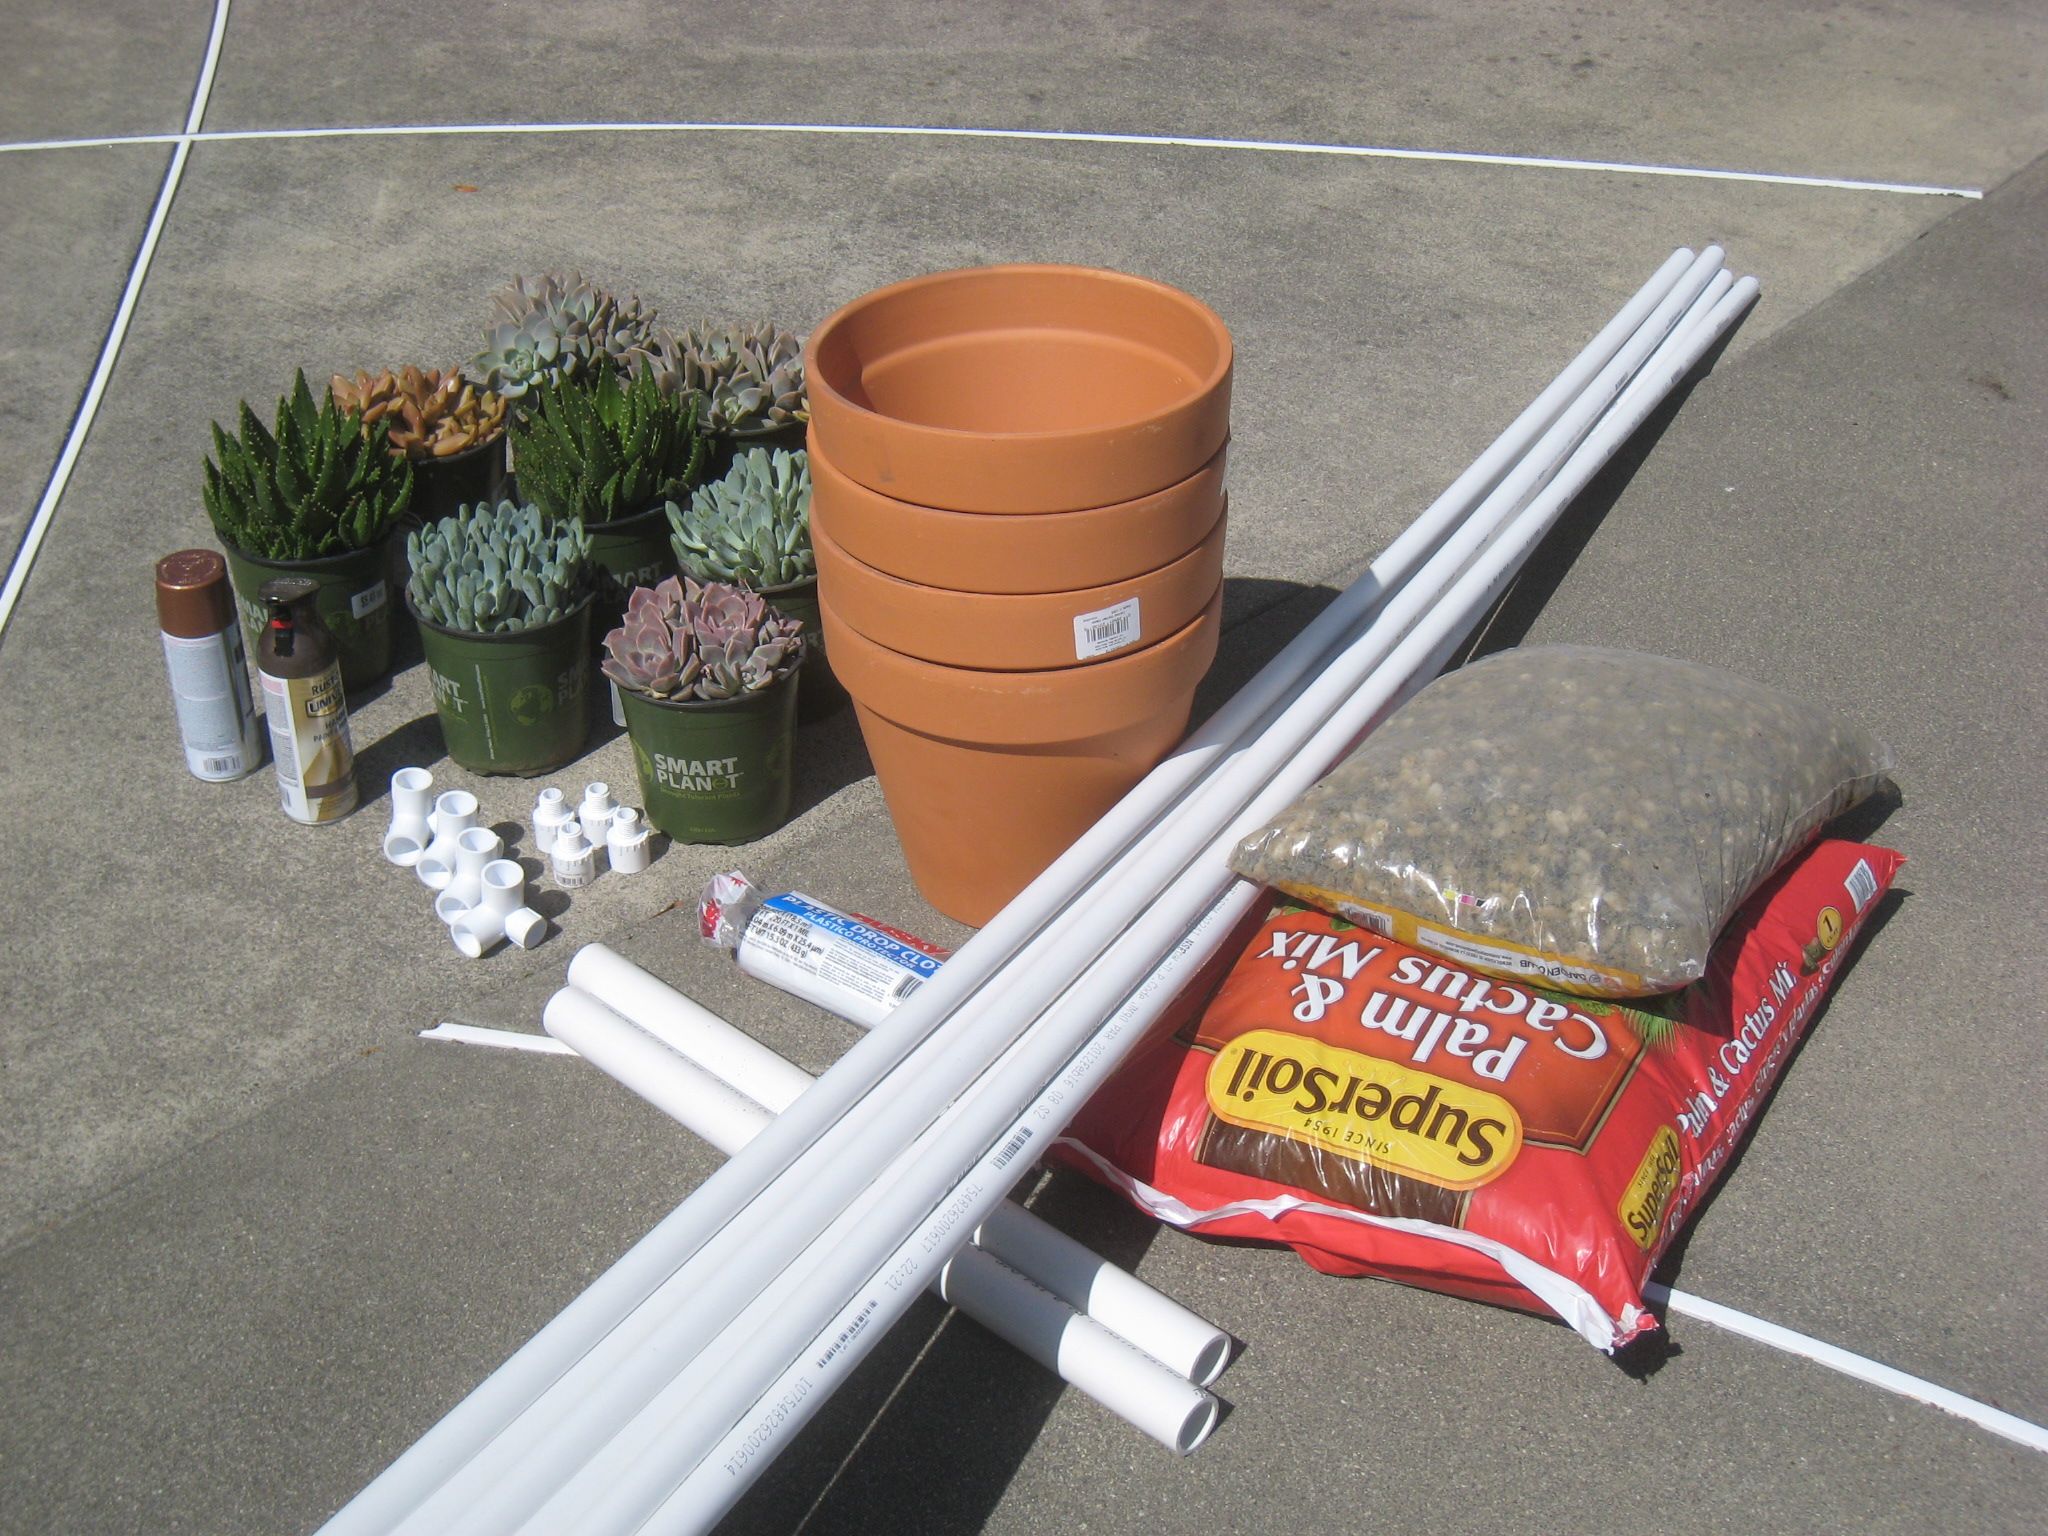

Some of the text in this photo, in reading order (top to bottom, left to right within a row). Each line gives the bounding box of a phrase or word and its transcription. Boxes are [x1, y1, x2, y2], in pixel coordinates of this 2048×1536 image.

[654, 753, 738, 776] SMART
[782, 895, 846, 925] PLASTIC
[850, 923, 900, 951] DROP
[901, 951, 942, 971] CLO
[804, 911, 854, 937] PLASTICO
[853, 933, 916, 968] PROTECTOR
[1823, 915, 1834, 933] 1
[1257, 930, 1385, 980] Mix
[1290, 972, 1528, 1082] Palm &
[1389, 955, 1609, 1060] Cactus
[1719, 998, 1775, 1076] Cactus
[1227, 1047, 1507, 1167] SuperSoil
[1708, 1066, 1731, 1098] &
[1303, 1117, 1390, 1155] SINCE 1954
[1627, 1135, 1680, 1242] SuperSoil
[884, 1256, 918, 1293] 22:21
